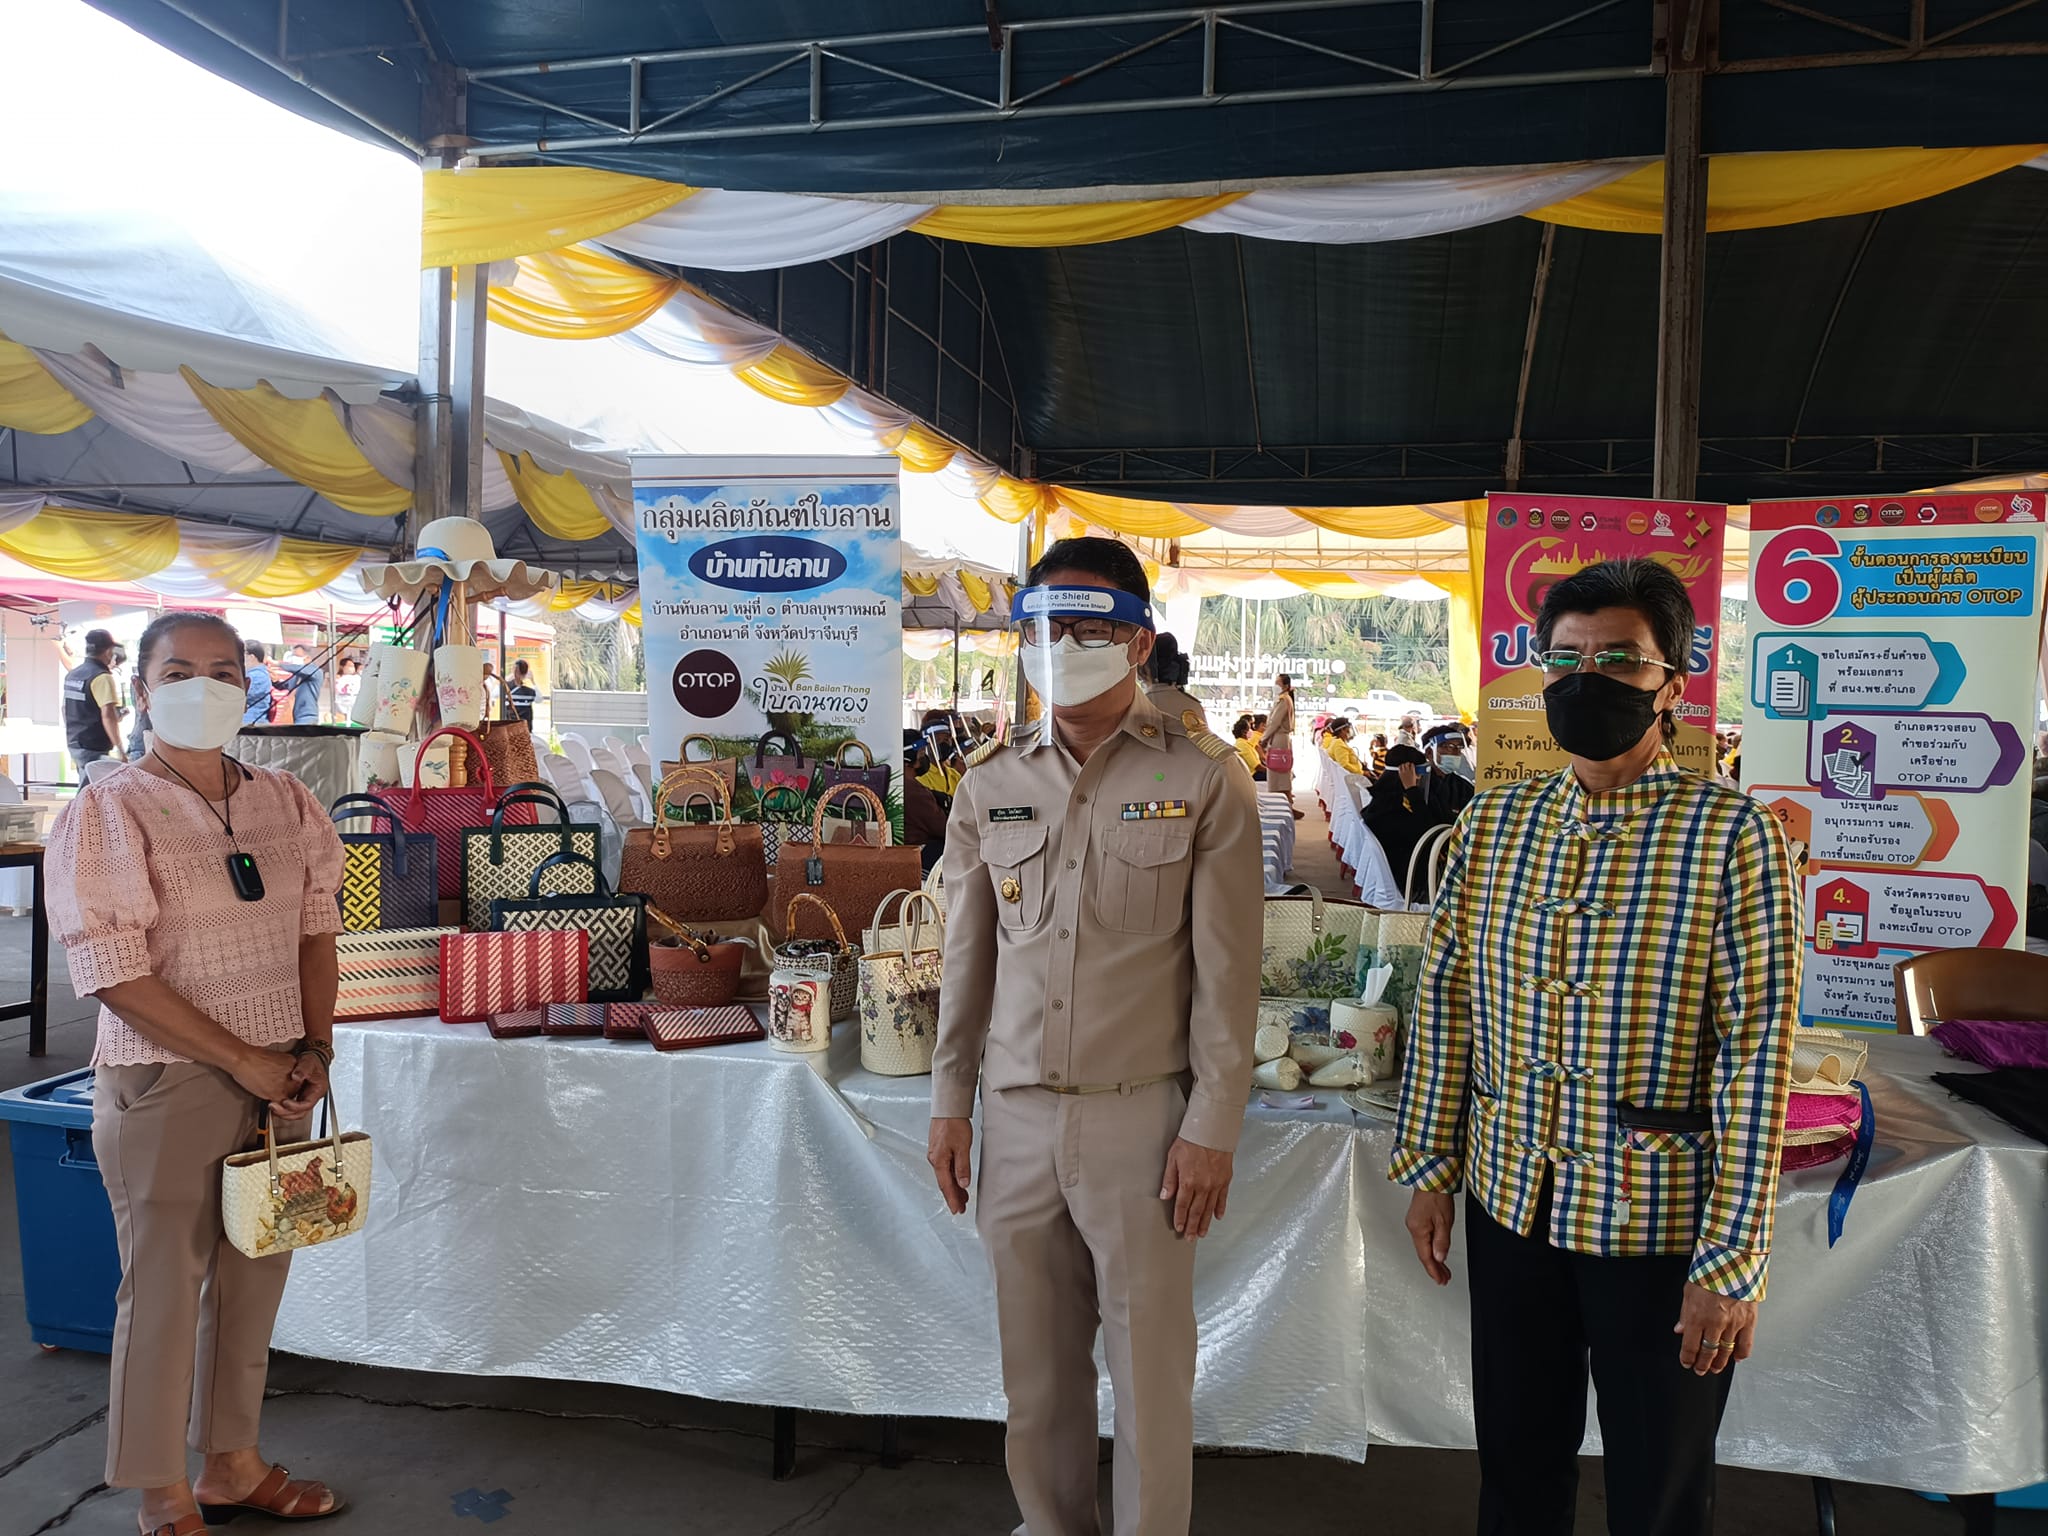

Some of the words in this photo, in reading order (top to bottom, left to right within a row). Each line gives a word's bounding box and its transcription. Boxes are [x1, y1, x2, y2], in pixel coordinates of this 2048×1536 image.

[643, 495, 892, 539] กลุ่มผลิตภัณฑ์ใบลาน
[1551, 515, 1570, 523] OTOP
[1850, 546, 2027, 567] ขั้นตอนการลงทะเบียน
[705, 551, 831, 579] บ้านทับลาน
[1755, 526, 1842, 628] 6
[1896, 567, 1977, 589] เป็นผู้ผลิต
[1062, 592, 1090, 601] Shield
[1852, 587, 1962, 609] ผู้ประกอบการ
[1967, 589, 2022, 604] OTOP
[652, 600, 728, 617] บ้านทับลาน
[733, 598, 761, 620] หมู่ที่
[782, 600, 887, 621] ตำบลบุพราหมณ์
[680, 624, 749, 641] อำเภอนาดี
[755, 625, 859, 646] จังหวัดปราจีนบุรี
[1785, 650, 1802, 665] 1.
[1837, 666, 1904, 677] พร้อมเอกสาร
[678, 672, 736, 688] OTOP
[753, 677, 868, 713] ใบลานทอง
[771, 684, 787, 692] บ้าน
[796, 683, 813, 692] Ban
[814, 684, 841, 693] Bailan
[843, 685, 871, 695] Thong
[1894, 720, 1977, 733] อำเภอตรวจสอบ
[1840, 729, 1859, 744] 2.
[1902, 738, 1967, 750] คำขอร่วมกับ
[1910, 754, 1957, 766] เครือข่าย
[1898, 773, 1931, 783] OTOP
[1935, 773, 1968, 784] อำเภอ
[1840, 800, 1899, 813] ประชุมคณะ
[1778, 808, 1794, 823] 3.
[1824, 817, 1884, 828] อนุกรรมการ
[1836, 832, 1901, 846] อำเภอรับรอง
[1887, 853, 1916, 863] OTOP
[1833, 888, 1851, 904] 4.
[1884, 886, 1970, 903] จังหวัดตรวจสอบ
[1890, 904, 1962, 919] ข้อมูลในระบบ
[1879, 922, 1934, 934] ลงทะเบียน
[1937, 926, 1972, 937] OTOP
[1832, 957, 1891, 971] ประชุมคณะ
[1816, 973, 1876, 987] อนุกรรมการ
[1823, 988, 1859, 1001] จังหวัด
